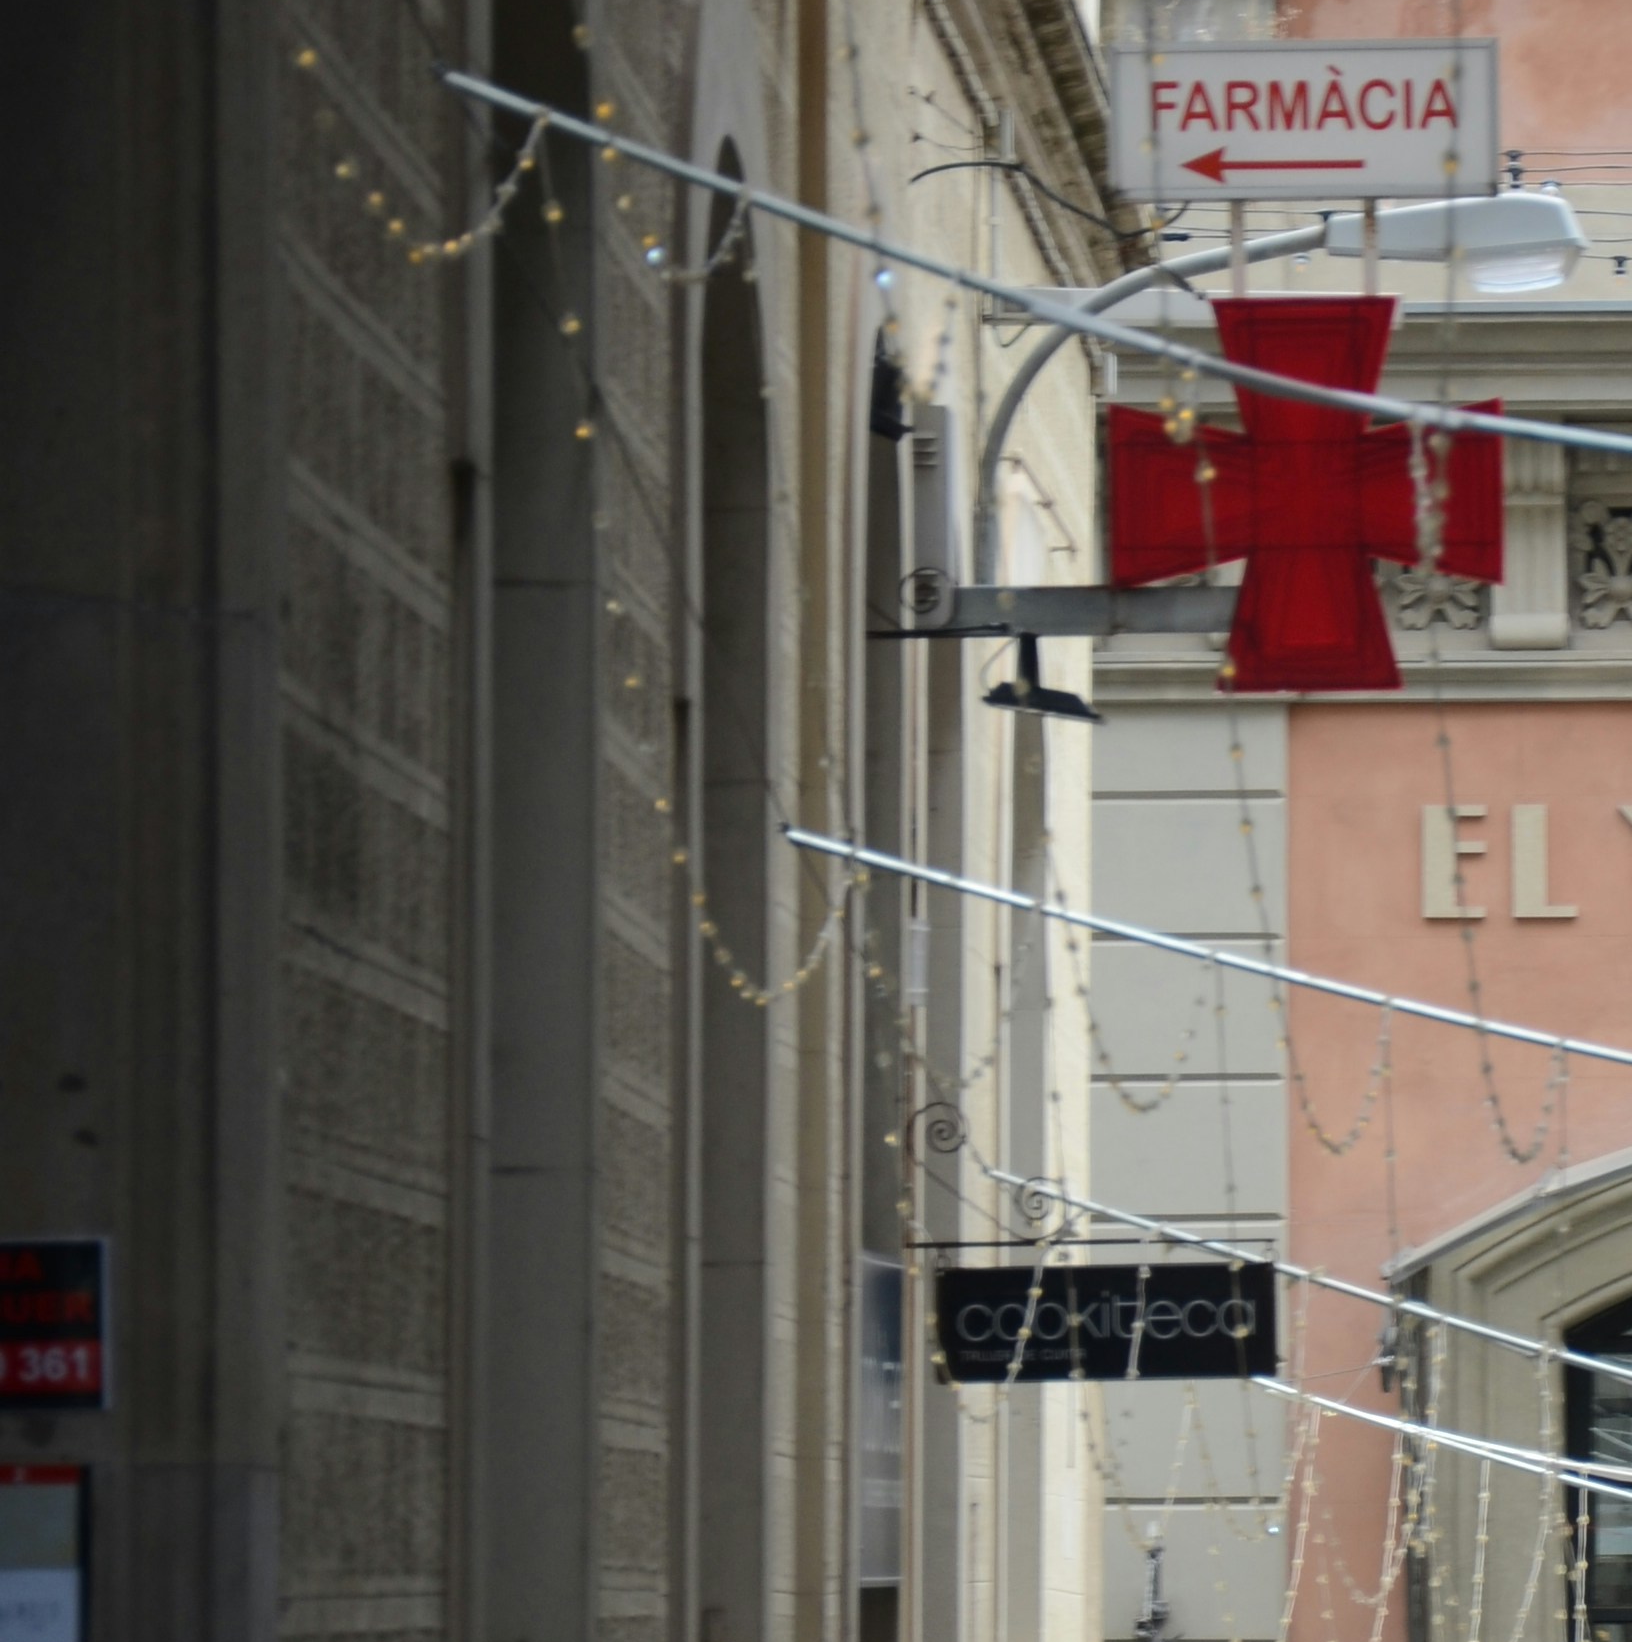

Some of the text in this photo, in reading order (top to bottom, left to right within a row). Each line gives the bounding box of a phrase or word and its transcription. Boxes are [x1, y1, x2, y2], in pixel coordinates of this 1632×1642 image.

[1151, 65, 1459, 132] FARMÀCIA
[1420, 802, 1579, 921] EL
[956, 1291, 1256, 1340] cookiteca
